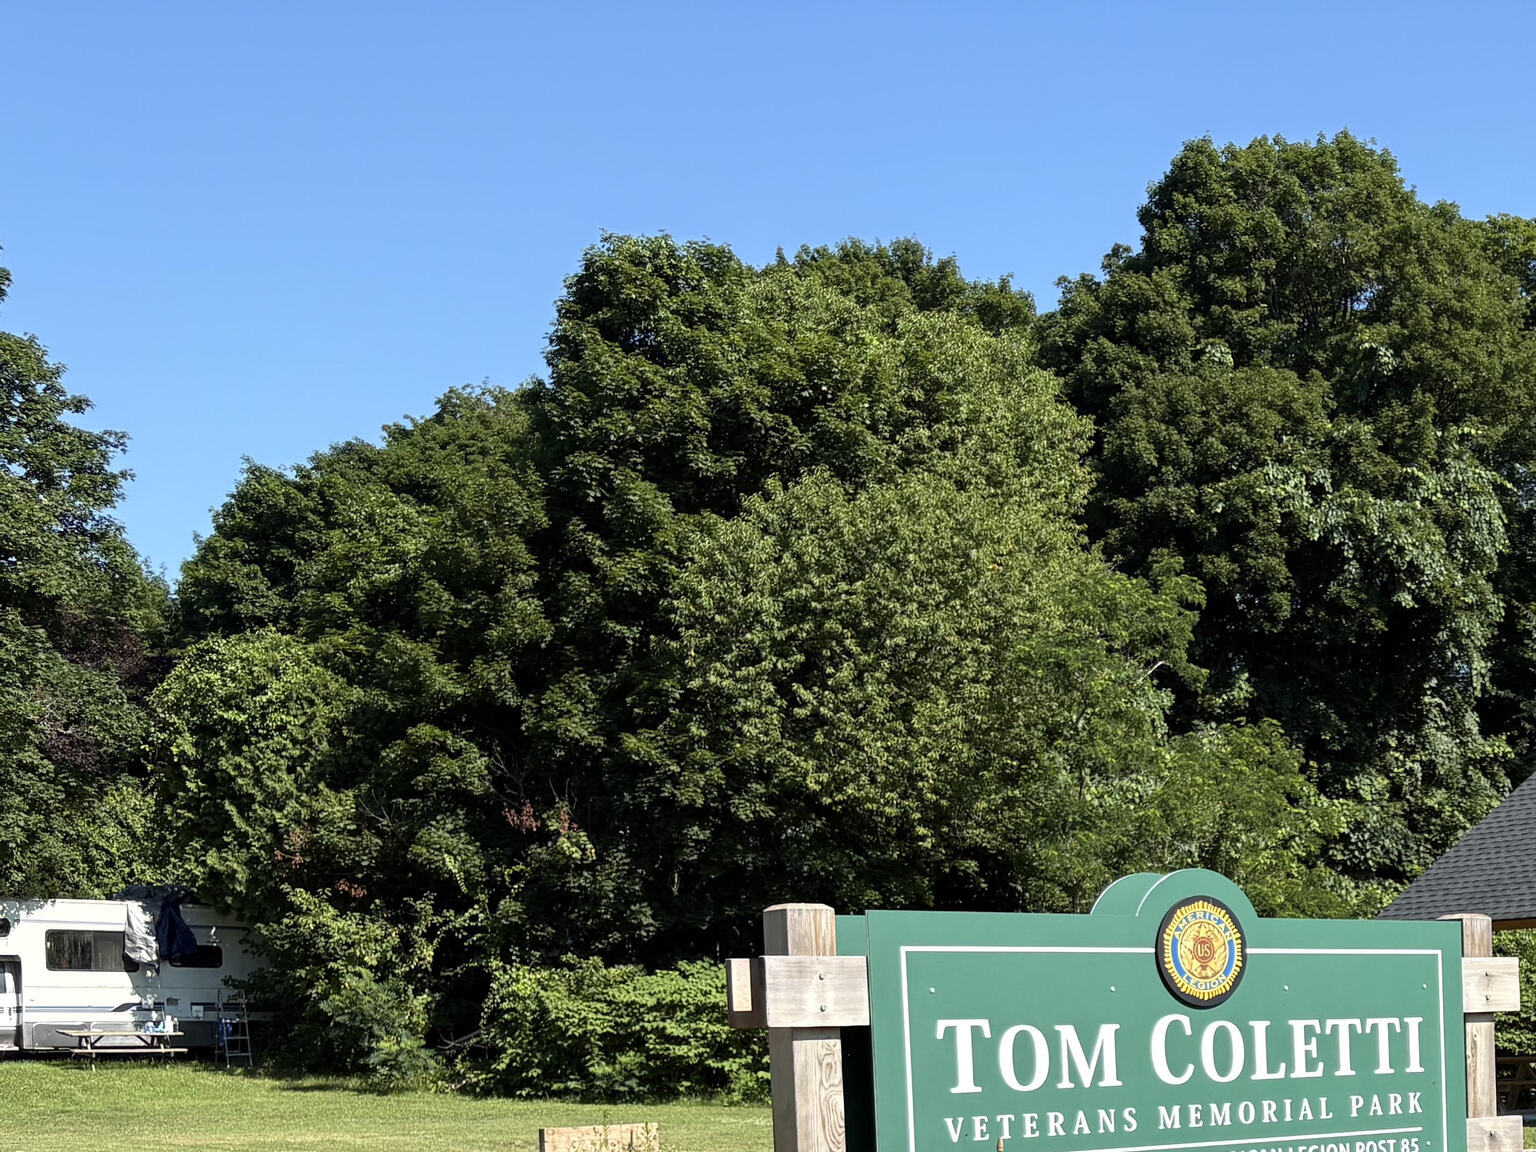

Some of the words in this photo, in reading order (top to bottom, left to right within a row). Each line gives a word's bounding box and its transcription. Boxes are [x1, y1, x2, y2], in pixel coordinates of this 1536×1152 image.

[1174, 911, 1233, 940] AMERICAN
[1197, 942, 1211, 958] US
[1182, 973, 1228, 991] LEGION
[935, 1018, 1123, 1094] TOM
[1150, 1013, 1425, 1085] COLETTI
[945, 1107, 1138, 1143] VETERANS
[1158, 1097, 1333, 1130] MEMORIAL
[1349, 1091, 1424, 1118] PARK
